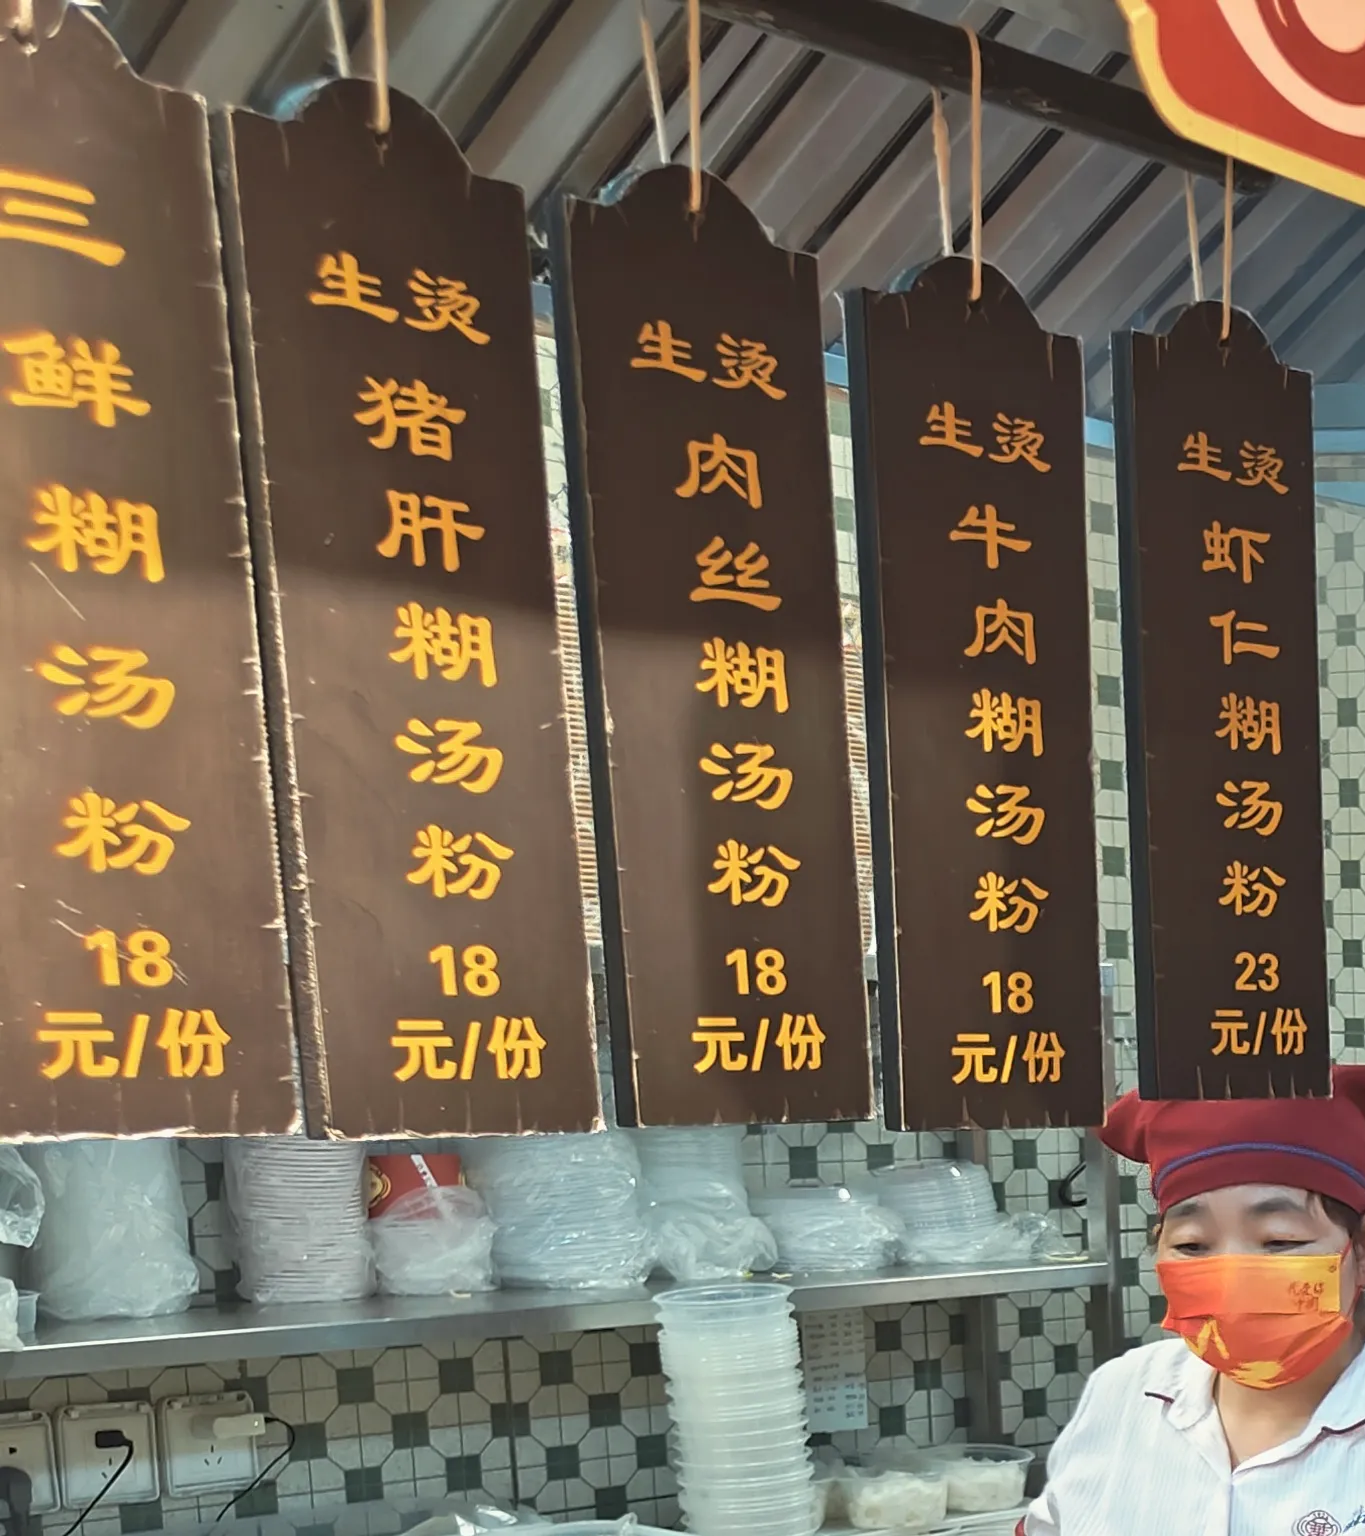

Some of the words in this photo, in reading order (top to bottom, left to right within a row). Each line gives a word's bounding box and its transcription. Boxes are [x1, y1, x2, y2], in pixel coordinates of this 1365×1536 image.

[310, 252, 489, 344] 生烫
[631, 321, 786, 399] 生烫
[920, 403, 1050, 471] 生烫
[1178, 433, 1288, 493] 生烫
[0, 170, 192, 877] 三鲜糊汤粉
[354, 377, 514, 900] 猪肝糊汤粉
[676, 434, 800, 906] 肉丝糊汤粉
[950, 505, 1048, 934] 牛肉糊汤粉
[1203, 522, 1286, 917] 虾仁糊汤粉
[84, 928, 174, 987] 18
[429, 944, 500, 997] 18
[726, 949, 786, 995] 18
[1235, 952, 1279, 991] 23
[983, 972, 1033, 1013] 18
[37, 1008, 231, 1079] 元/份
[390, 1016, 546, 1081] 元/份
[692, 1013, 825, 1073] 元/份
[952, 1032, 1064, 1084] 元/份
[1211, 1009, 1307, 1057] 元/份
